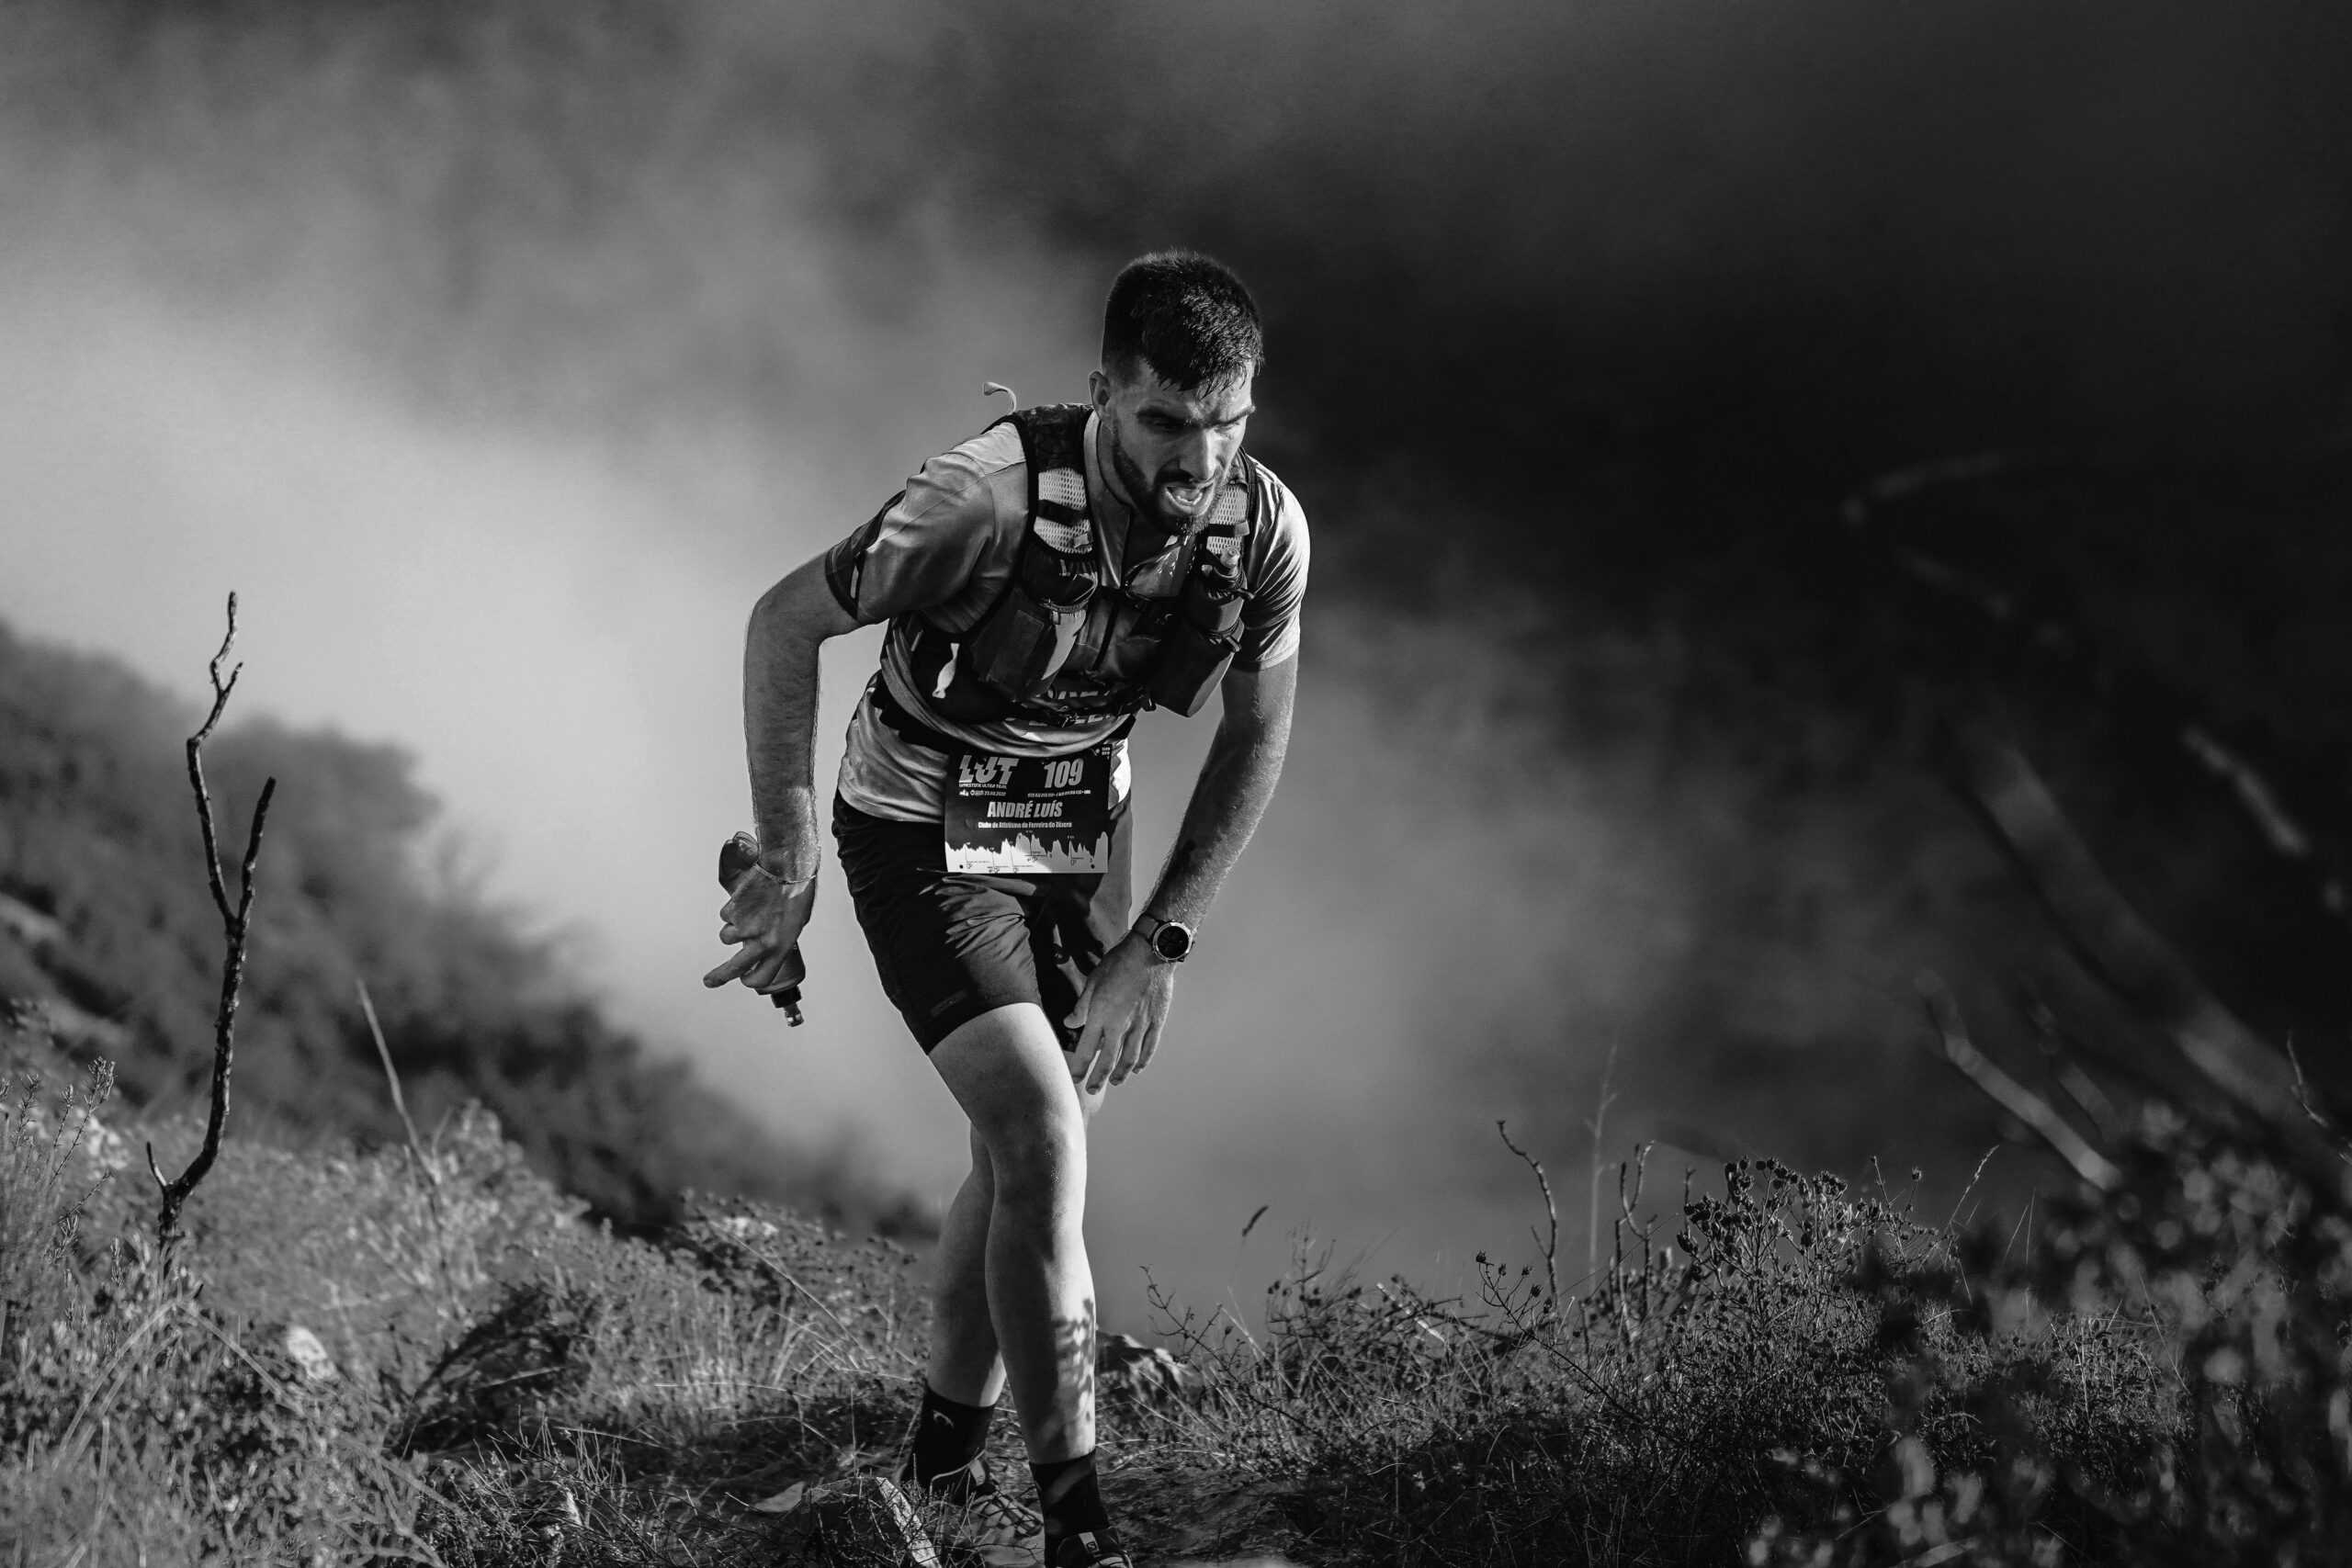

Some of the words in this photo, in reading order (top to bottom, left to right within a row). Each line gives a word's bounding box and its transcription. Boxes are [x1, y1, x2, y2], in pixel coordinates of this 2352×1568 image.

[958, 754, 1020, 784] LUT
[1044, 758, 1084, 788] 109
[987, 800, 1034, 818] ANDRÉ
[1034, 799, 1063, 818] LUÍS
